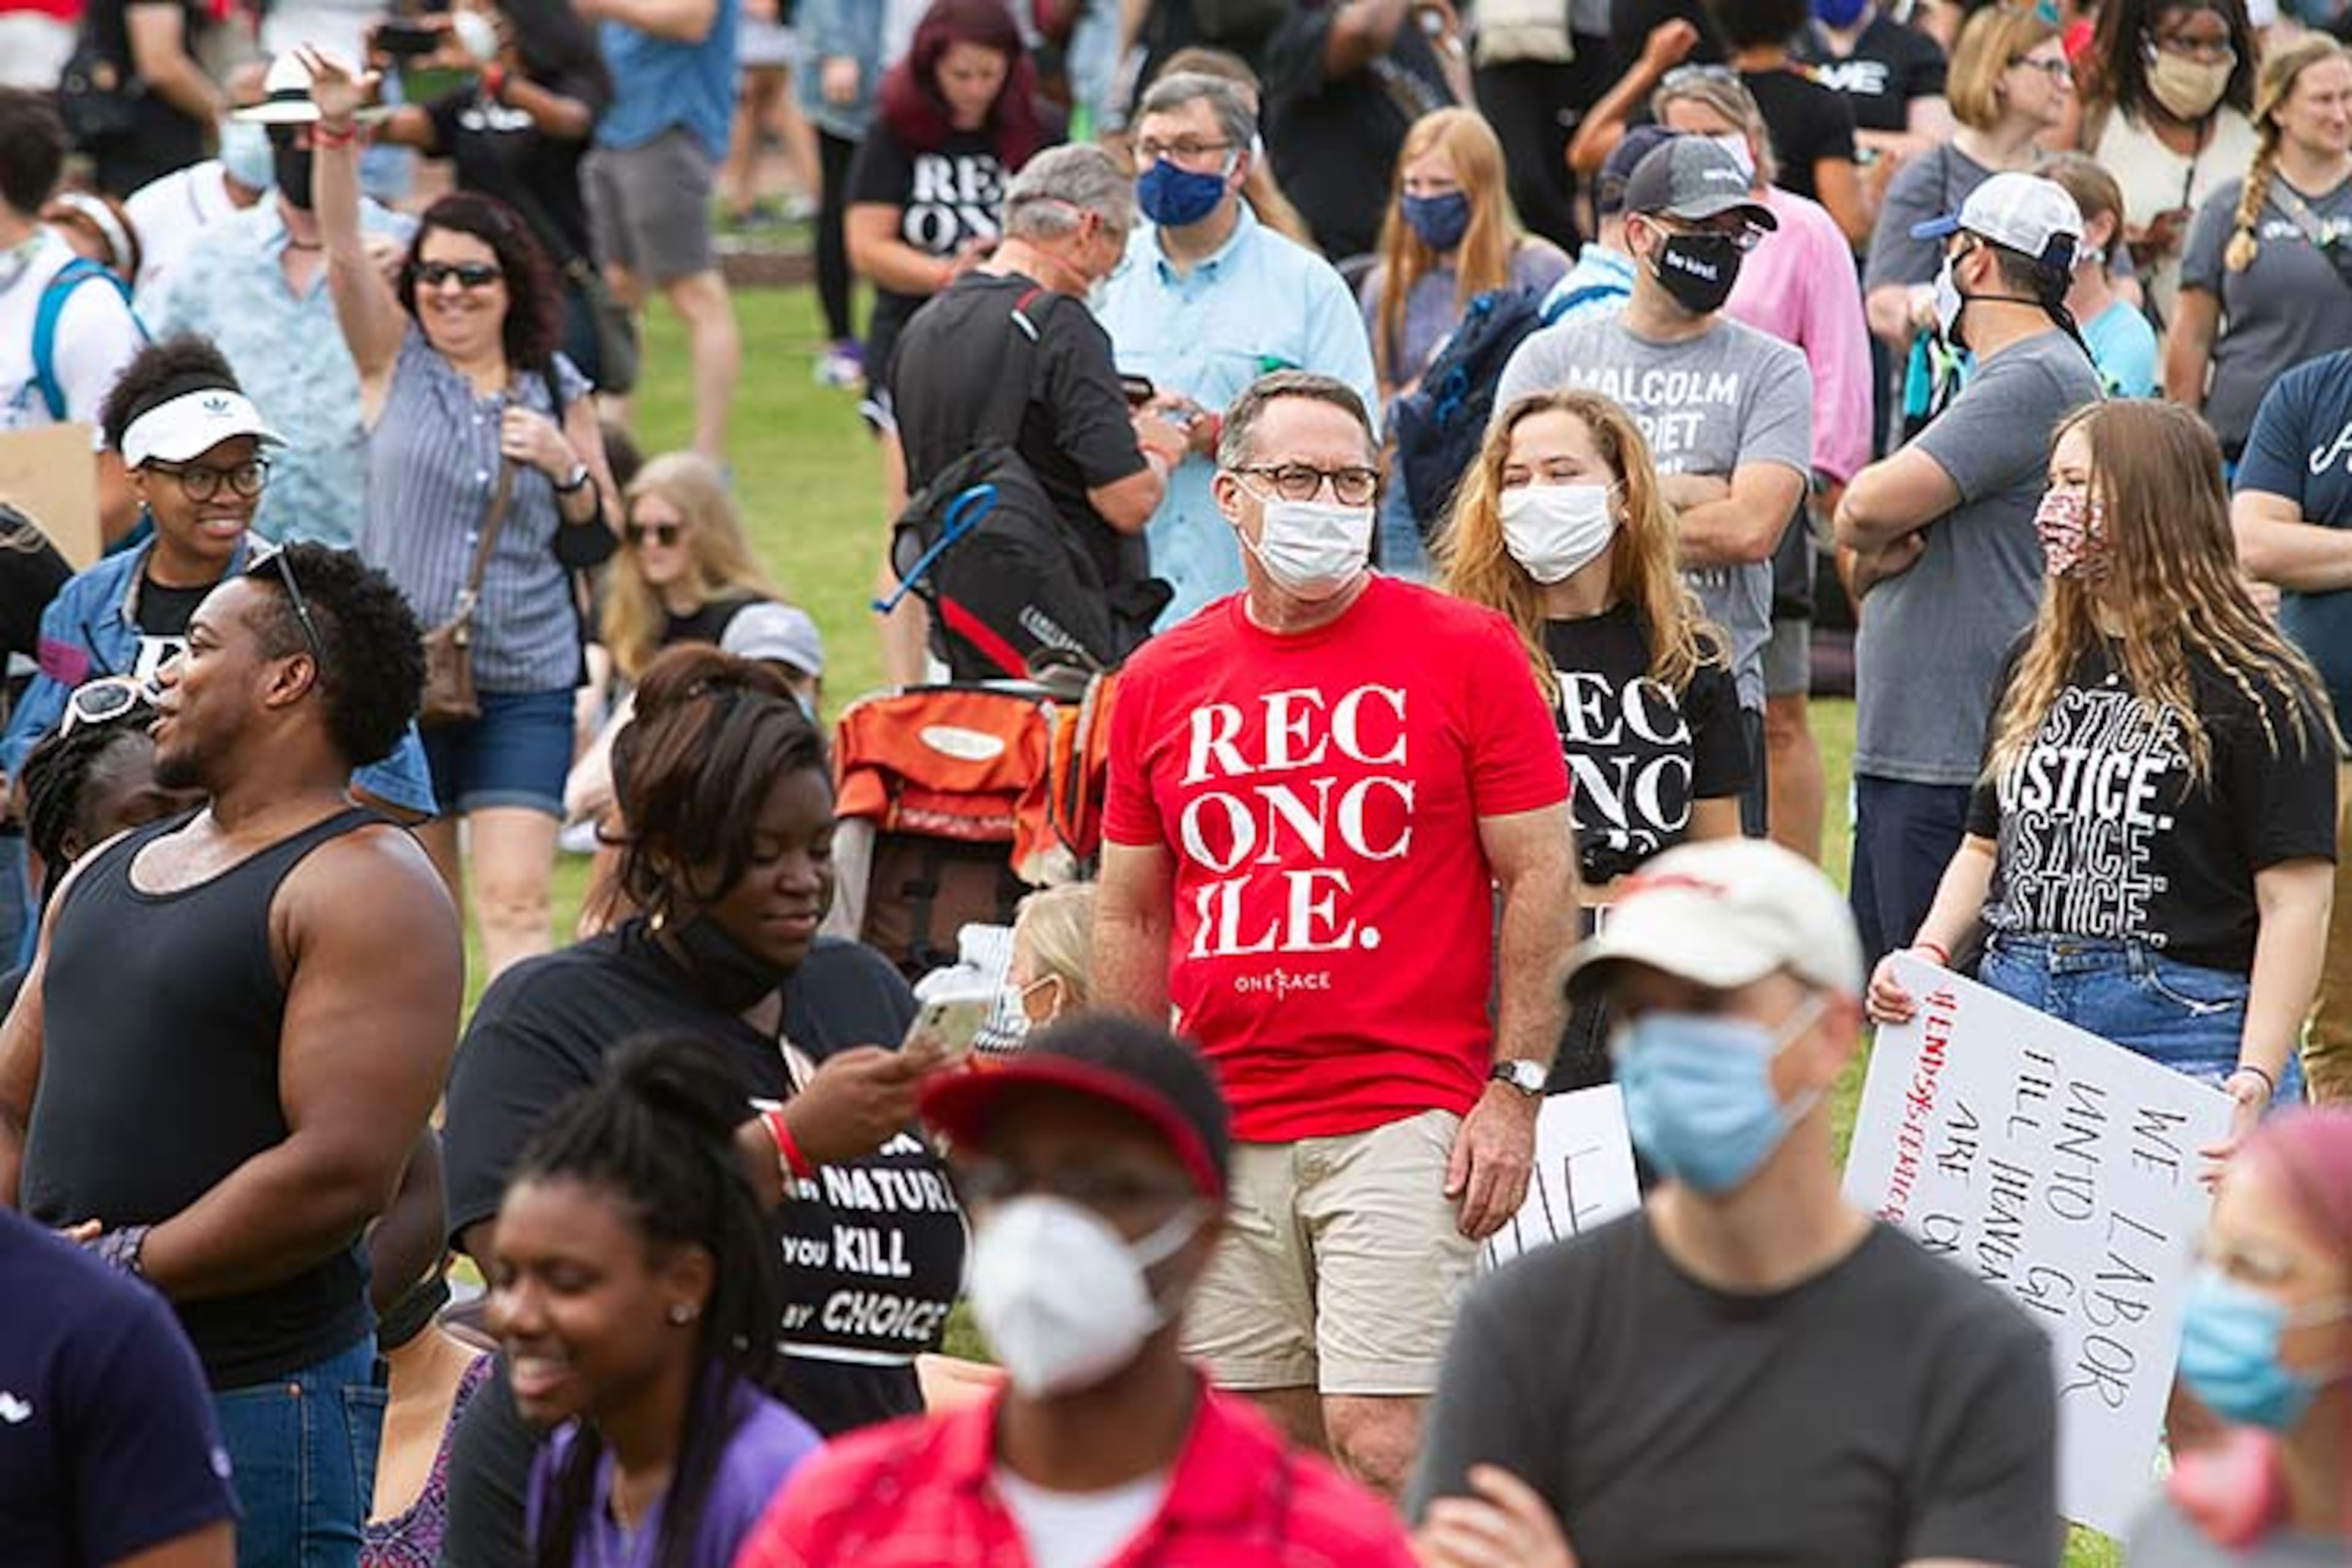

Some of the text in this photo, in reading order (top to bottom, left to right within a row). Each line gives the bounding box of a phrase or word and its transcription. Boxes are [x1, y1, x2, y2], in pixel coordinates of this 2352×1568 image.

[1179, 683, 1407, 787] REC
[1554, 671, 1692, 745] EC
[1180, 775, 1417, 873] ONC
[1187, 867, 1381, 959] ILE.
[2008, 1046, 2059, 1140] TILL
[1935, 1100, 1979, 1188] ARE
[2044, 1079, 2108, 1221] UNTO
[782, 1224, 911, 1277] YOU KILL
[2059, 1106, 2187, 1409] WE LABOR
